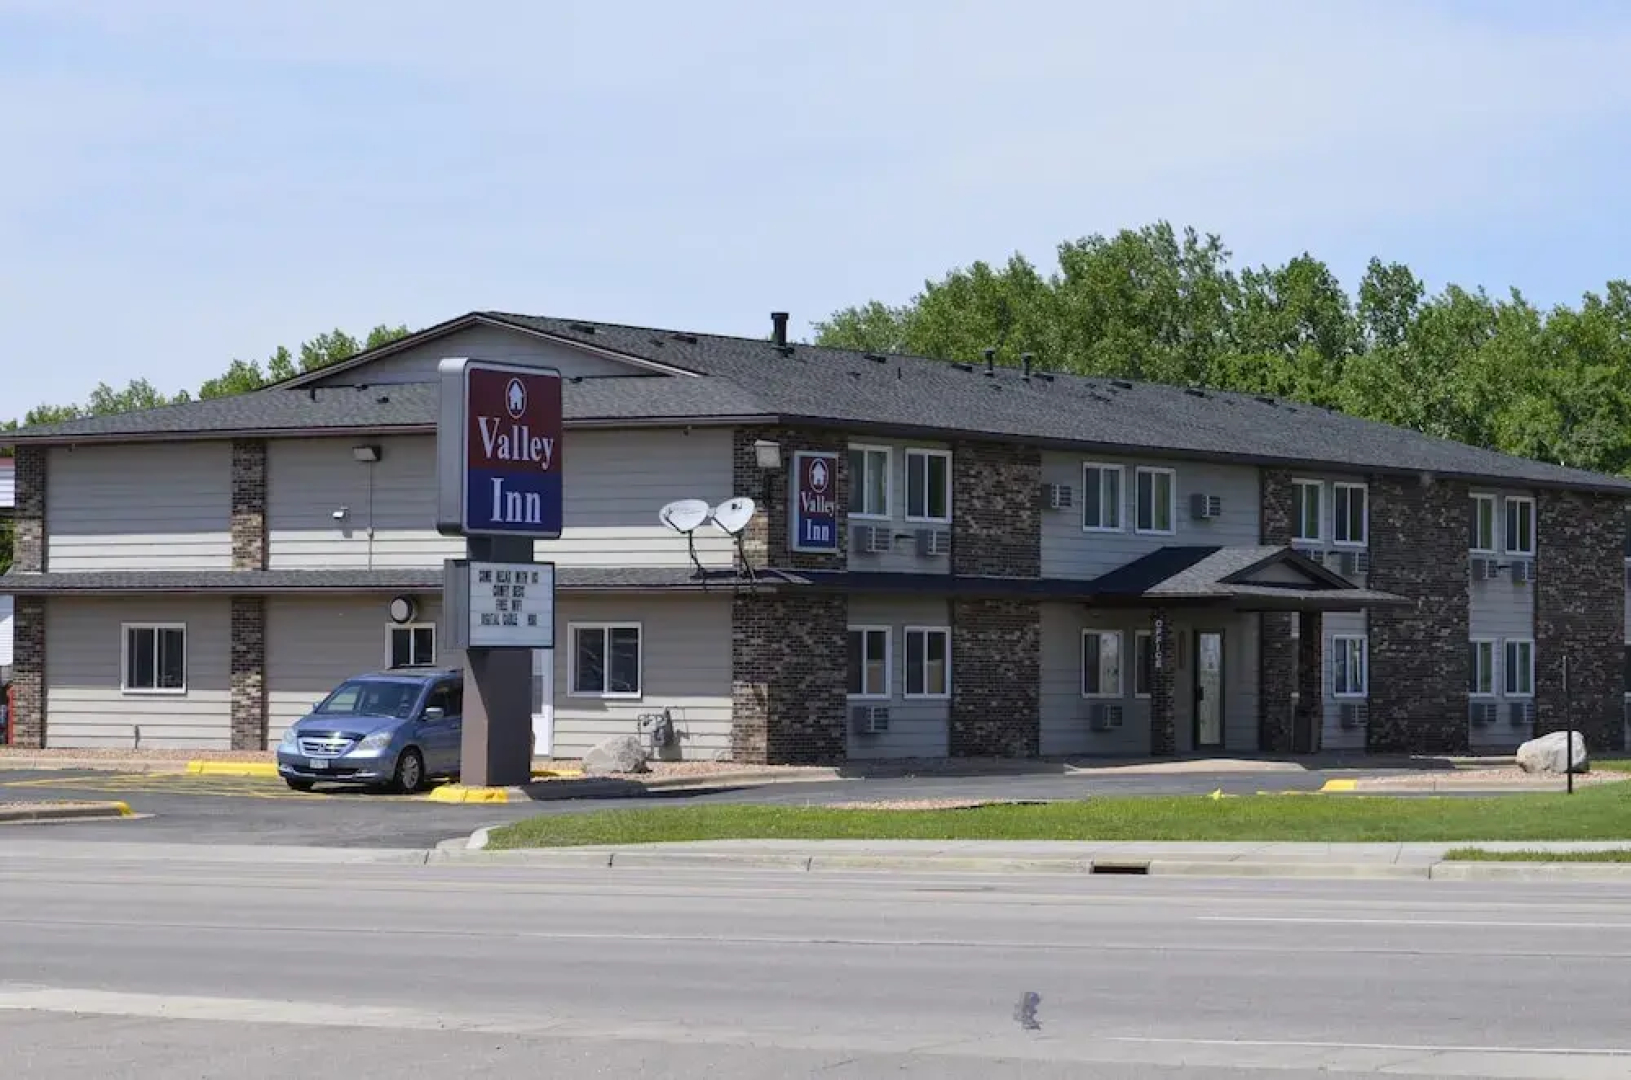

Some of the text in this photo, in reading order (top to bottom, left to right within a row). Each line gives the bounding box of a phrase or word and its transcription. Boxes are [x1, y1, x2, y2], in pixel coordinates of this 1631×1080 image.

[477, 416, 554, 471] Valley
[489, 477, 543, 524] Inn
[801, 492, 834, 517] Valley
[806, 519, 829, 541] Inn
